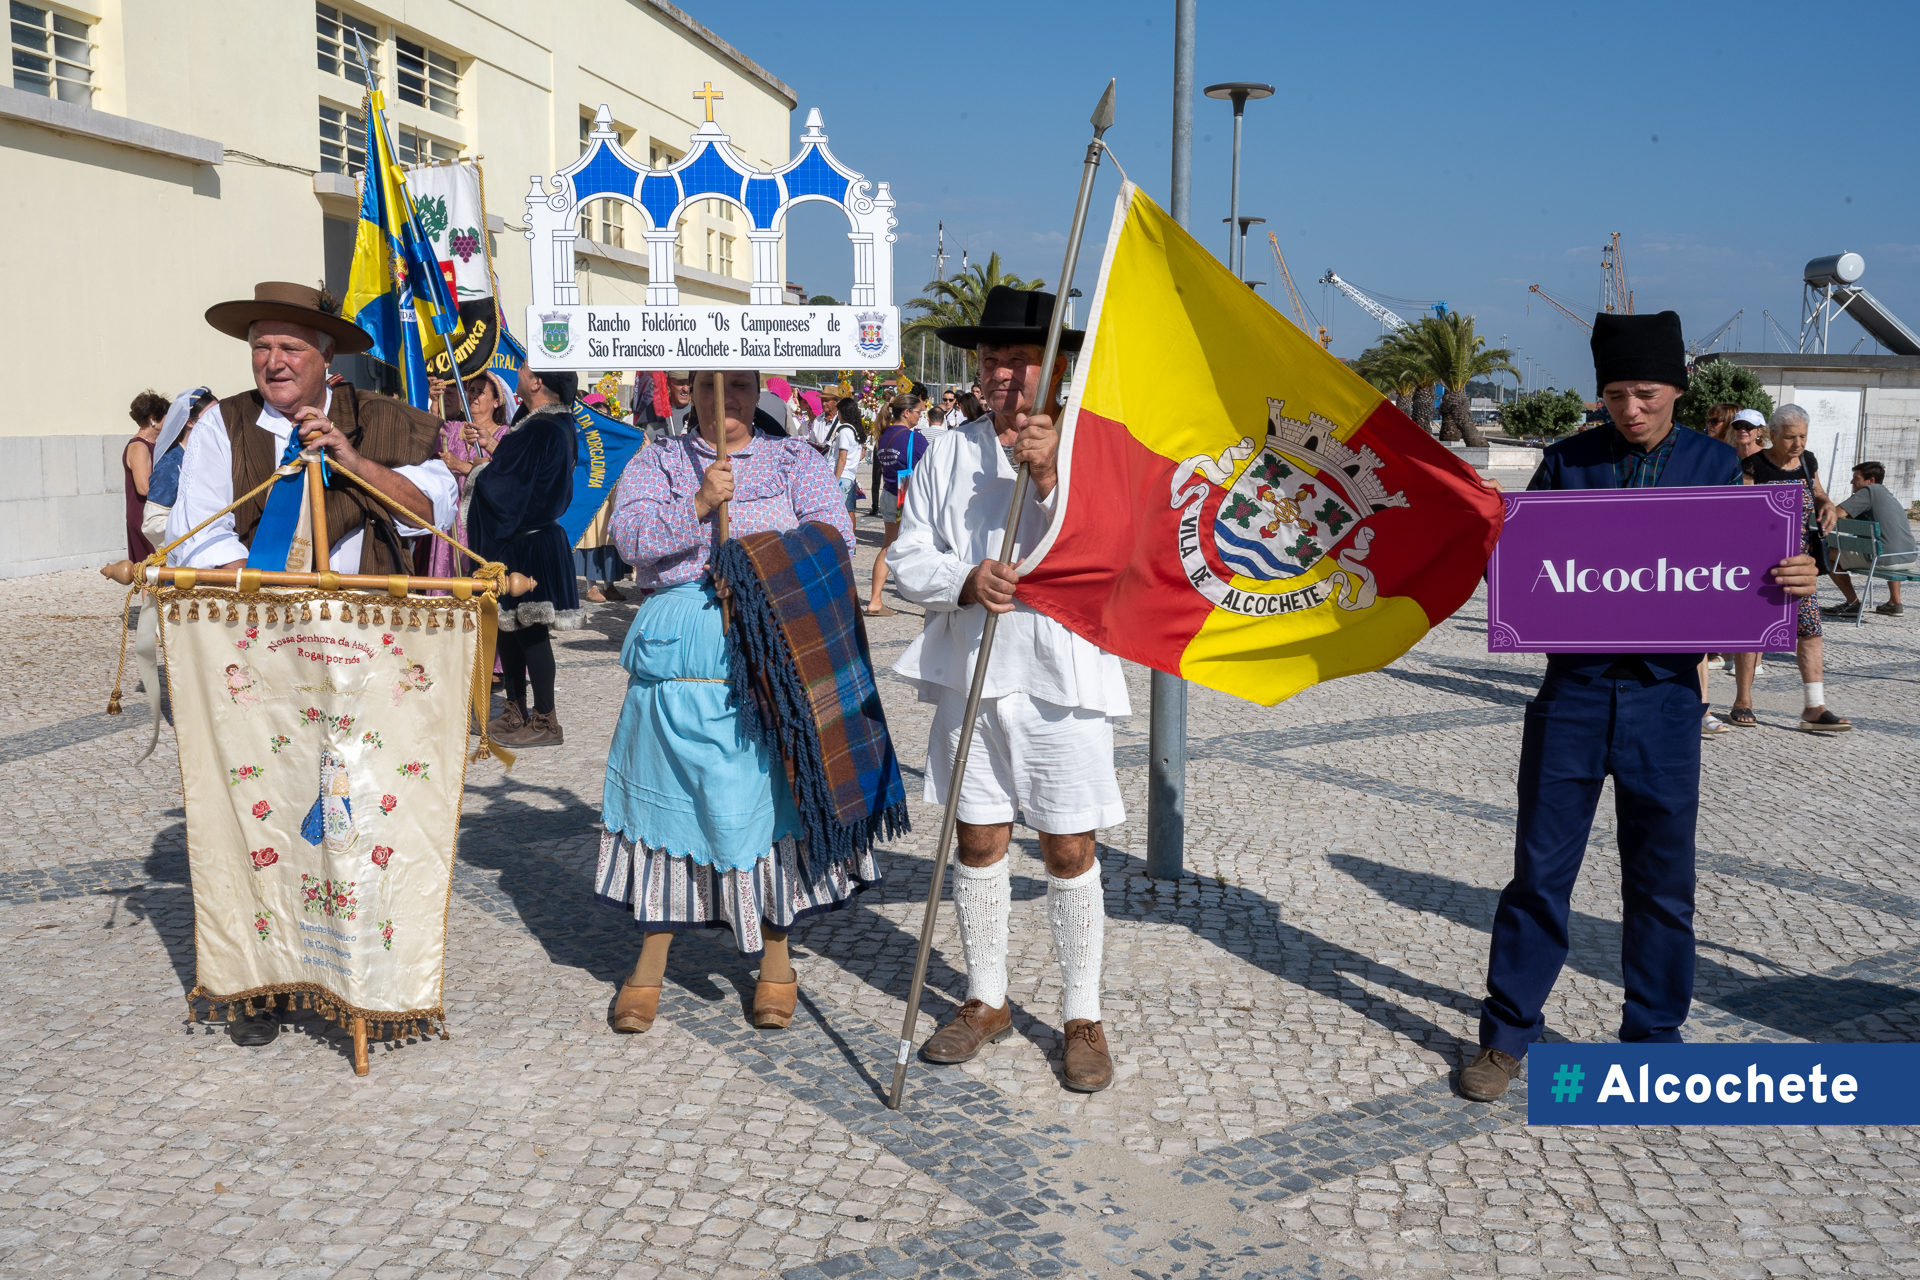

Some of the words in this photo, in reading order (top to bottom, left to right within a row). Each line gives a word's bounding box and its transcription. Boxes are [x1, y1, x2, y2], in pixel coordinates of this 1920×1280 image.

[588, 312, 630, 331] Rancho
[642, 312, 697, 331] Folclórico
[828, 313, 841, 332] de
[589, 338, 609, 357] São
[612, 338, 665, 357] Francisco
[676, 337, 730, 357] Alcochete
[740, 337, 771, 357] Baixa
[773, 337, 841, 357] Estremadura
[576, 413, 595, 430] DA
[585, 429, 606, 489] MORGADINHA
[1180, 515, 1198, 559] VILA
[1190, 565, 1212, 588] DE
[1220, 586, 1325, 615] ALCOCHETE
[1531, 557, 1750, 593] Alcochete
[267, 634, 296, 653] Nossa
[296, 633, 336, 645] Senhora
[337, 637, 350, 648] da
[297, 647, 325, 662] Rogai
[325, 655, 344, 666] por
[344, 655, 361, 665] nós
[299, 921, 327, 934] Rancho
[303, 938, 314, 948] Os
[303, 954, 312, 964] de
[312, 956, 325, 967] São
